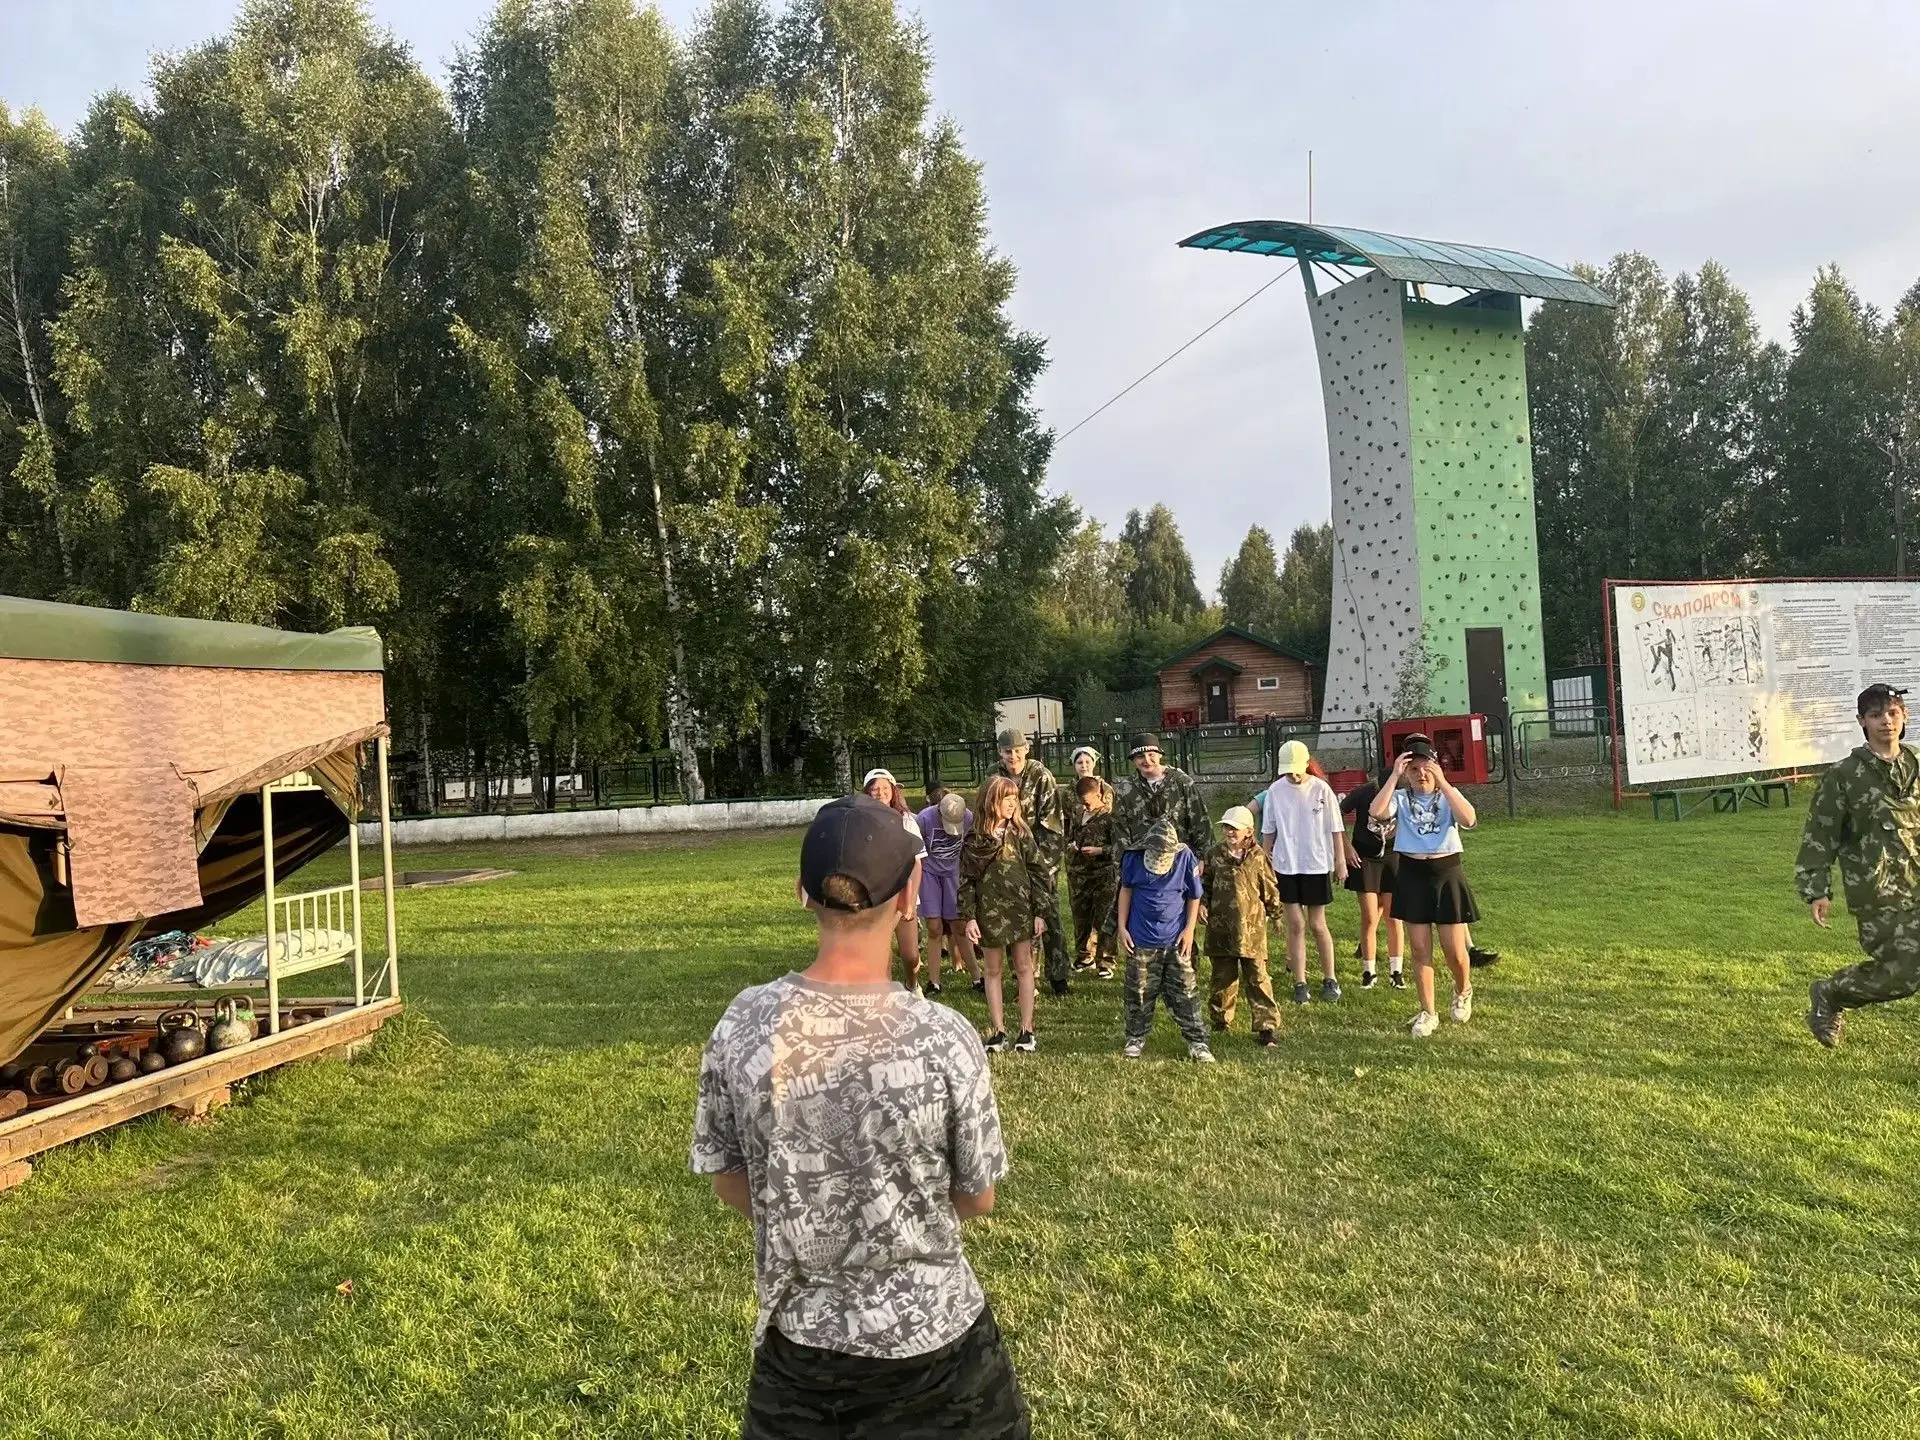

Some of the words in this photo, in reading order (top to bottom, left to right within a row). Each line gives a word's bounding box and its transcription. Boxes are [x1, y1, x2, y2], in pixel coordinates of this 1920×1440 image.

[1652, 590, 1742, 619] СКАЛОДРОМ
[776, 1071, 840, 1100] SMILE
[868, 1055, 928, 1097] FUN
